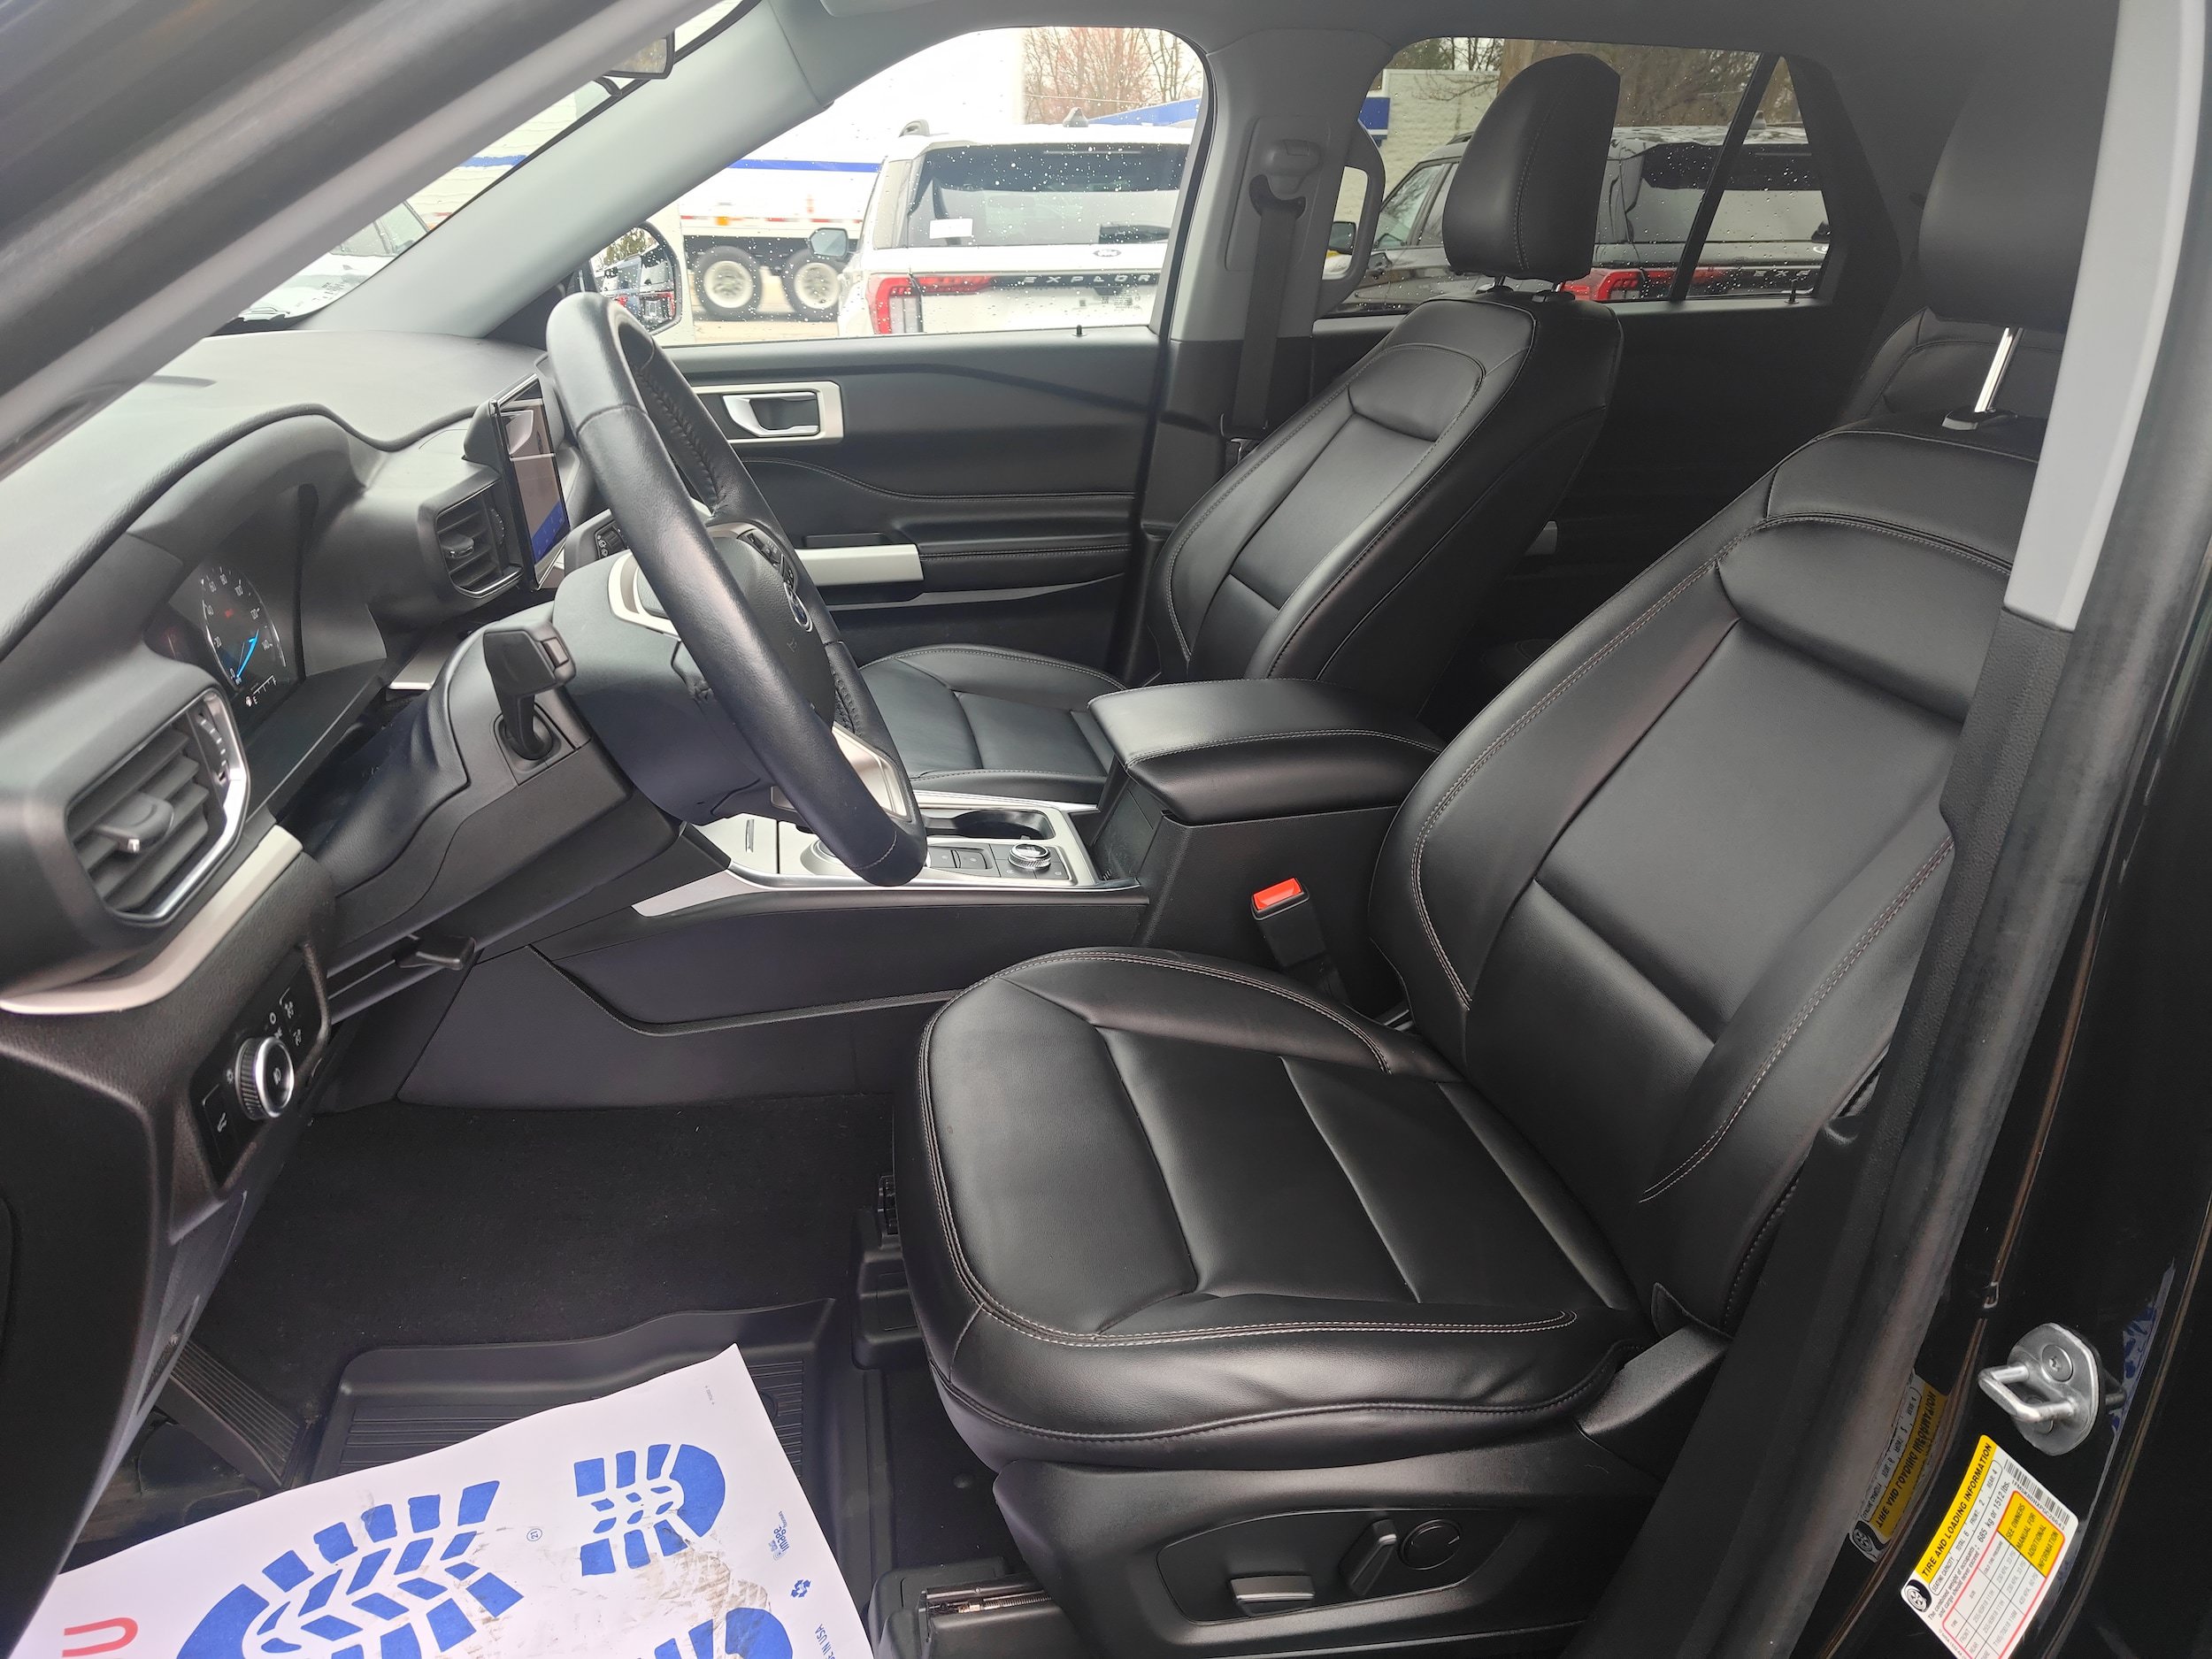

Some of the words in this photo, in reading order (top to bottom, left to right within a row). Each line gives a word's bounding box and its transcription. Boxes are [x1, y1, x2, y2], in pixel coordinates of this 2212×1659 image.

[1922, 1556, 1937, 1578] TIRE
[1935, 1538, 1948, 1558] AND
[1945, 1501, 1967, 1539] LOADING
[1964, 1442, 1992, 1502] INFORMATION
[1991, 1510, 1997, 1519] or
[1993, 1490, 2005, 1510] 1512
[1977, 1527, 1988, 1543] 685
[1985, 1518, 1995, 1528] kg
[2006, 1527, 2014, 1540] SEE
[2017, 1524, 2031, 1550] MANUAL
[2027, 1512, 2036, 1526] FOR
[2028, 1523, 2046, 1559] ADDITIONAL
[2037, 1530, 2058, 1571] INFORMATION
[1928, 1610, 1936, 1620] The
[1934, 1589, 1950, 1612] combined
[1947, 1574, 1959, 1591] weight
[1960, 1546, 1975, 1570] occupants
[1932, 1574, 1945, 1592] SEATING
[1942, 1556, 1955, 1576] CAPACITY
[1944, 1595, 1955, 1609] cargo
[1952, 1579, 1963, 1596] should
[1961, 1568, 1970, 1581] never
[1969, 1550, 1980, 1569] exceed
[814, 1623, 827, 1646] USA
[821, 1641, 832, 1655] IN
